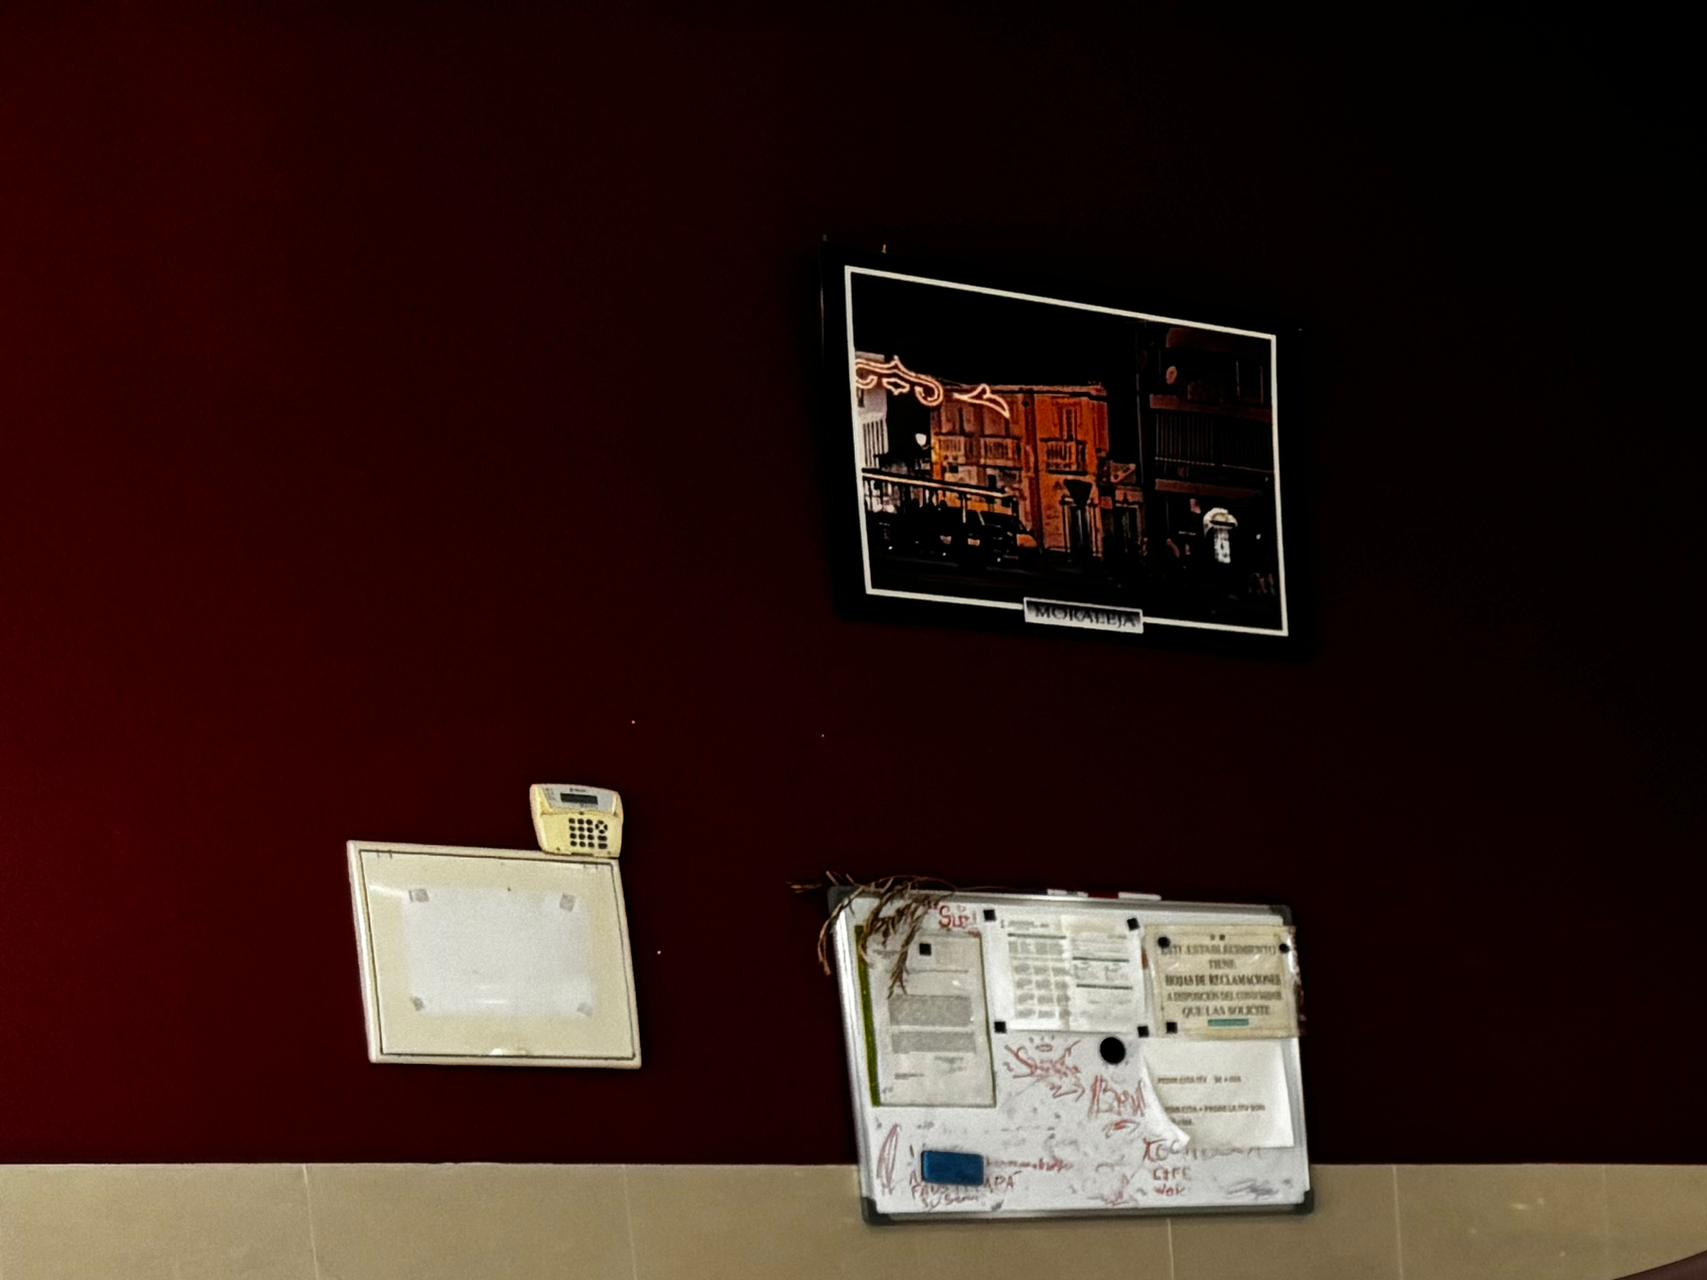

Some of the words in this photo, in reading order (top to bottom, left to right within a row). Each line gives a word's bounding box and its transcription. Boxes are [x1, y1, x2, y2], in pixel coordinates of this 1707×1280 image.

[1037, 605, 1136, 628] MORALEJA
[1165, 974, 1194, 987] HOJAS
[1195, 975, 1206, 987] DE
[1208, 974, 1282, 987] RECLAMACIONES
[1205, 1005, 1226, 1017] LAS
